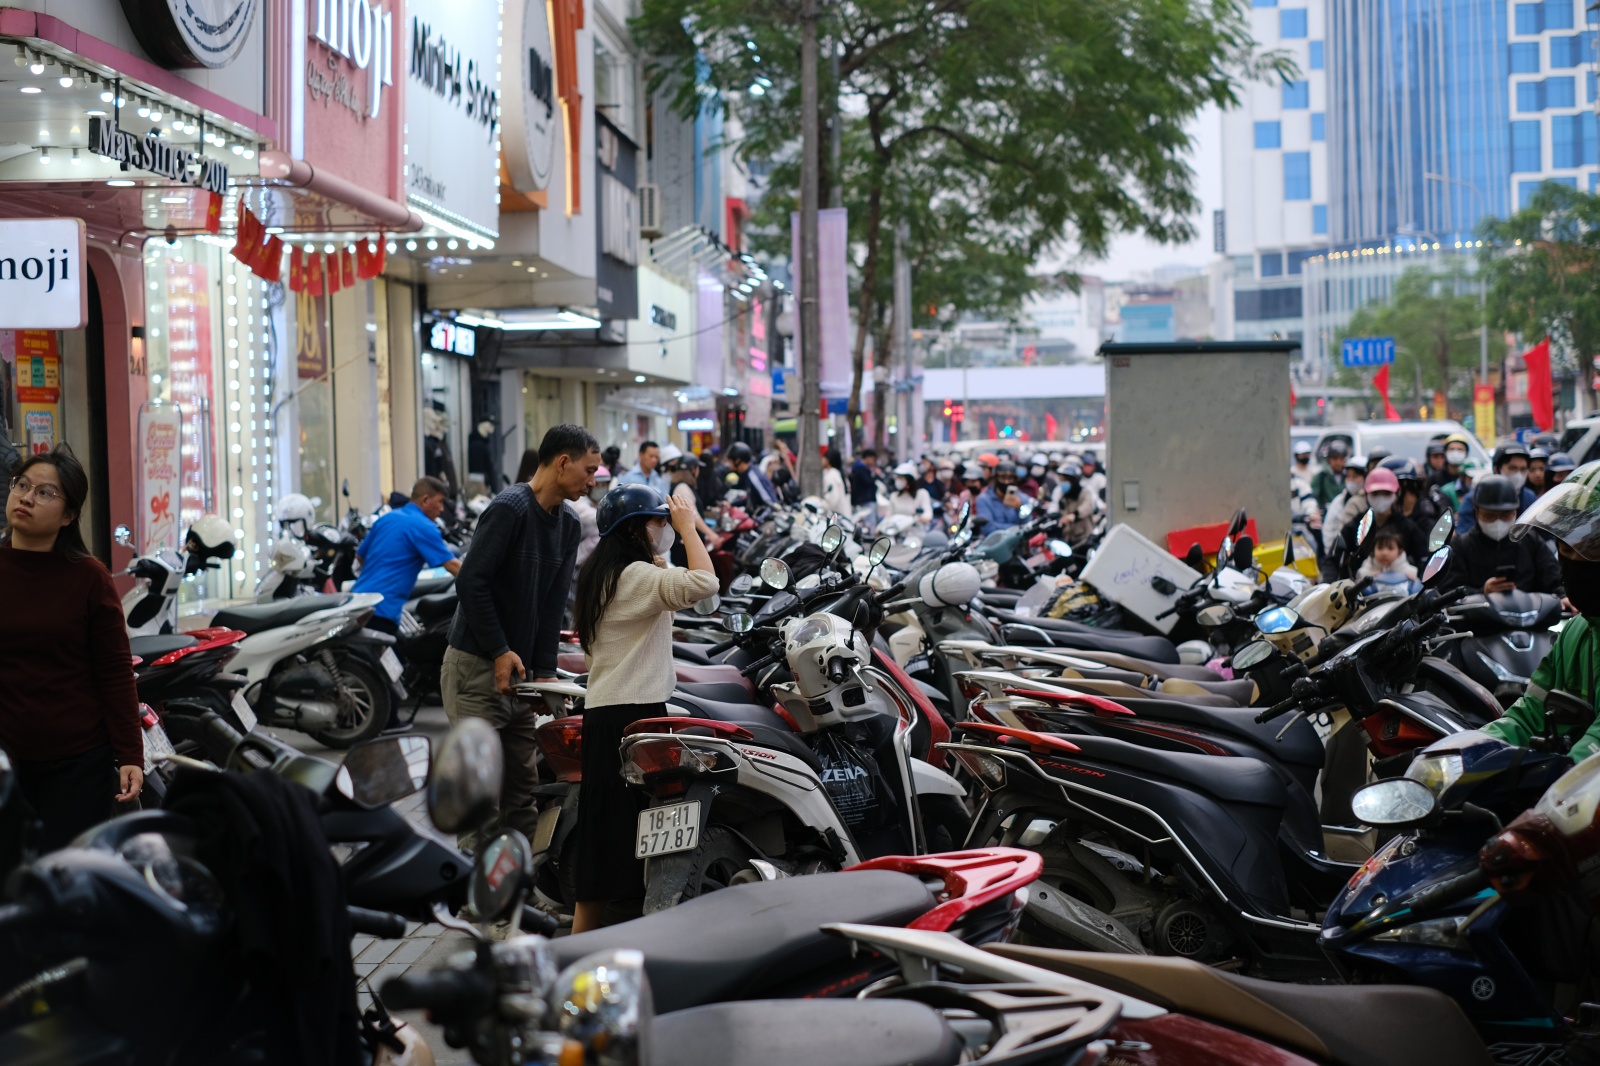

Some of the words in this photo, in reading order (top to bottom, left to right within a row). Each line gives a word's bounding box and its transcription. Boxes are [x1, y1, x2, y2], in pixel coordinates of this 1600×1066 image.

[741, 748, 777, 759] ISION
[649, 805, 690, 832] 18-H1
[640, 826, 695, 855] 577.87
